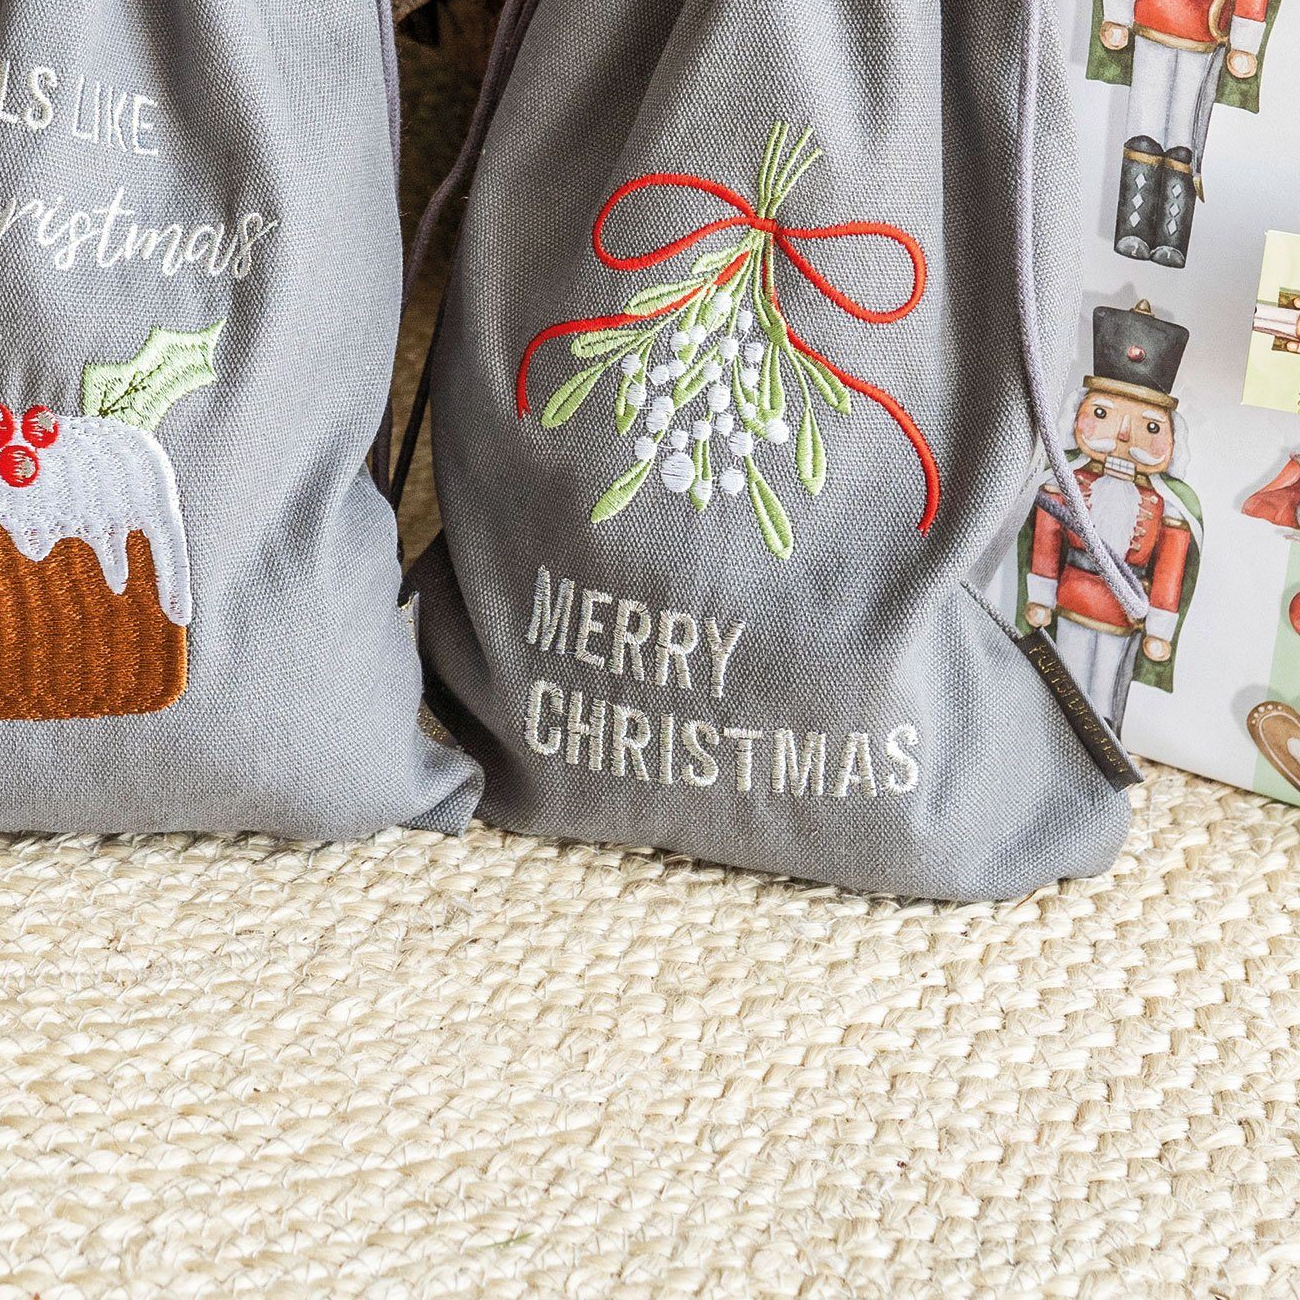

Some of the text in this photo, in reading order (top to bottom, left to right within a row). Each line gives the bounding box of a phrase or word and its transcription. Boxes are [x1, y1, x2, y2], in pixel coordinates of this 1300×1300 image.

[71, 77, 160, 157] LIKE
[525, 564, 747, 699] MERRY
[523, 679, 921, 799] CHRISTMAS
